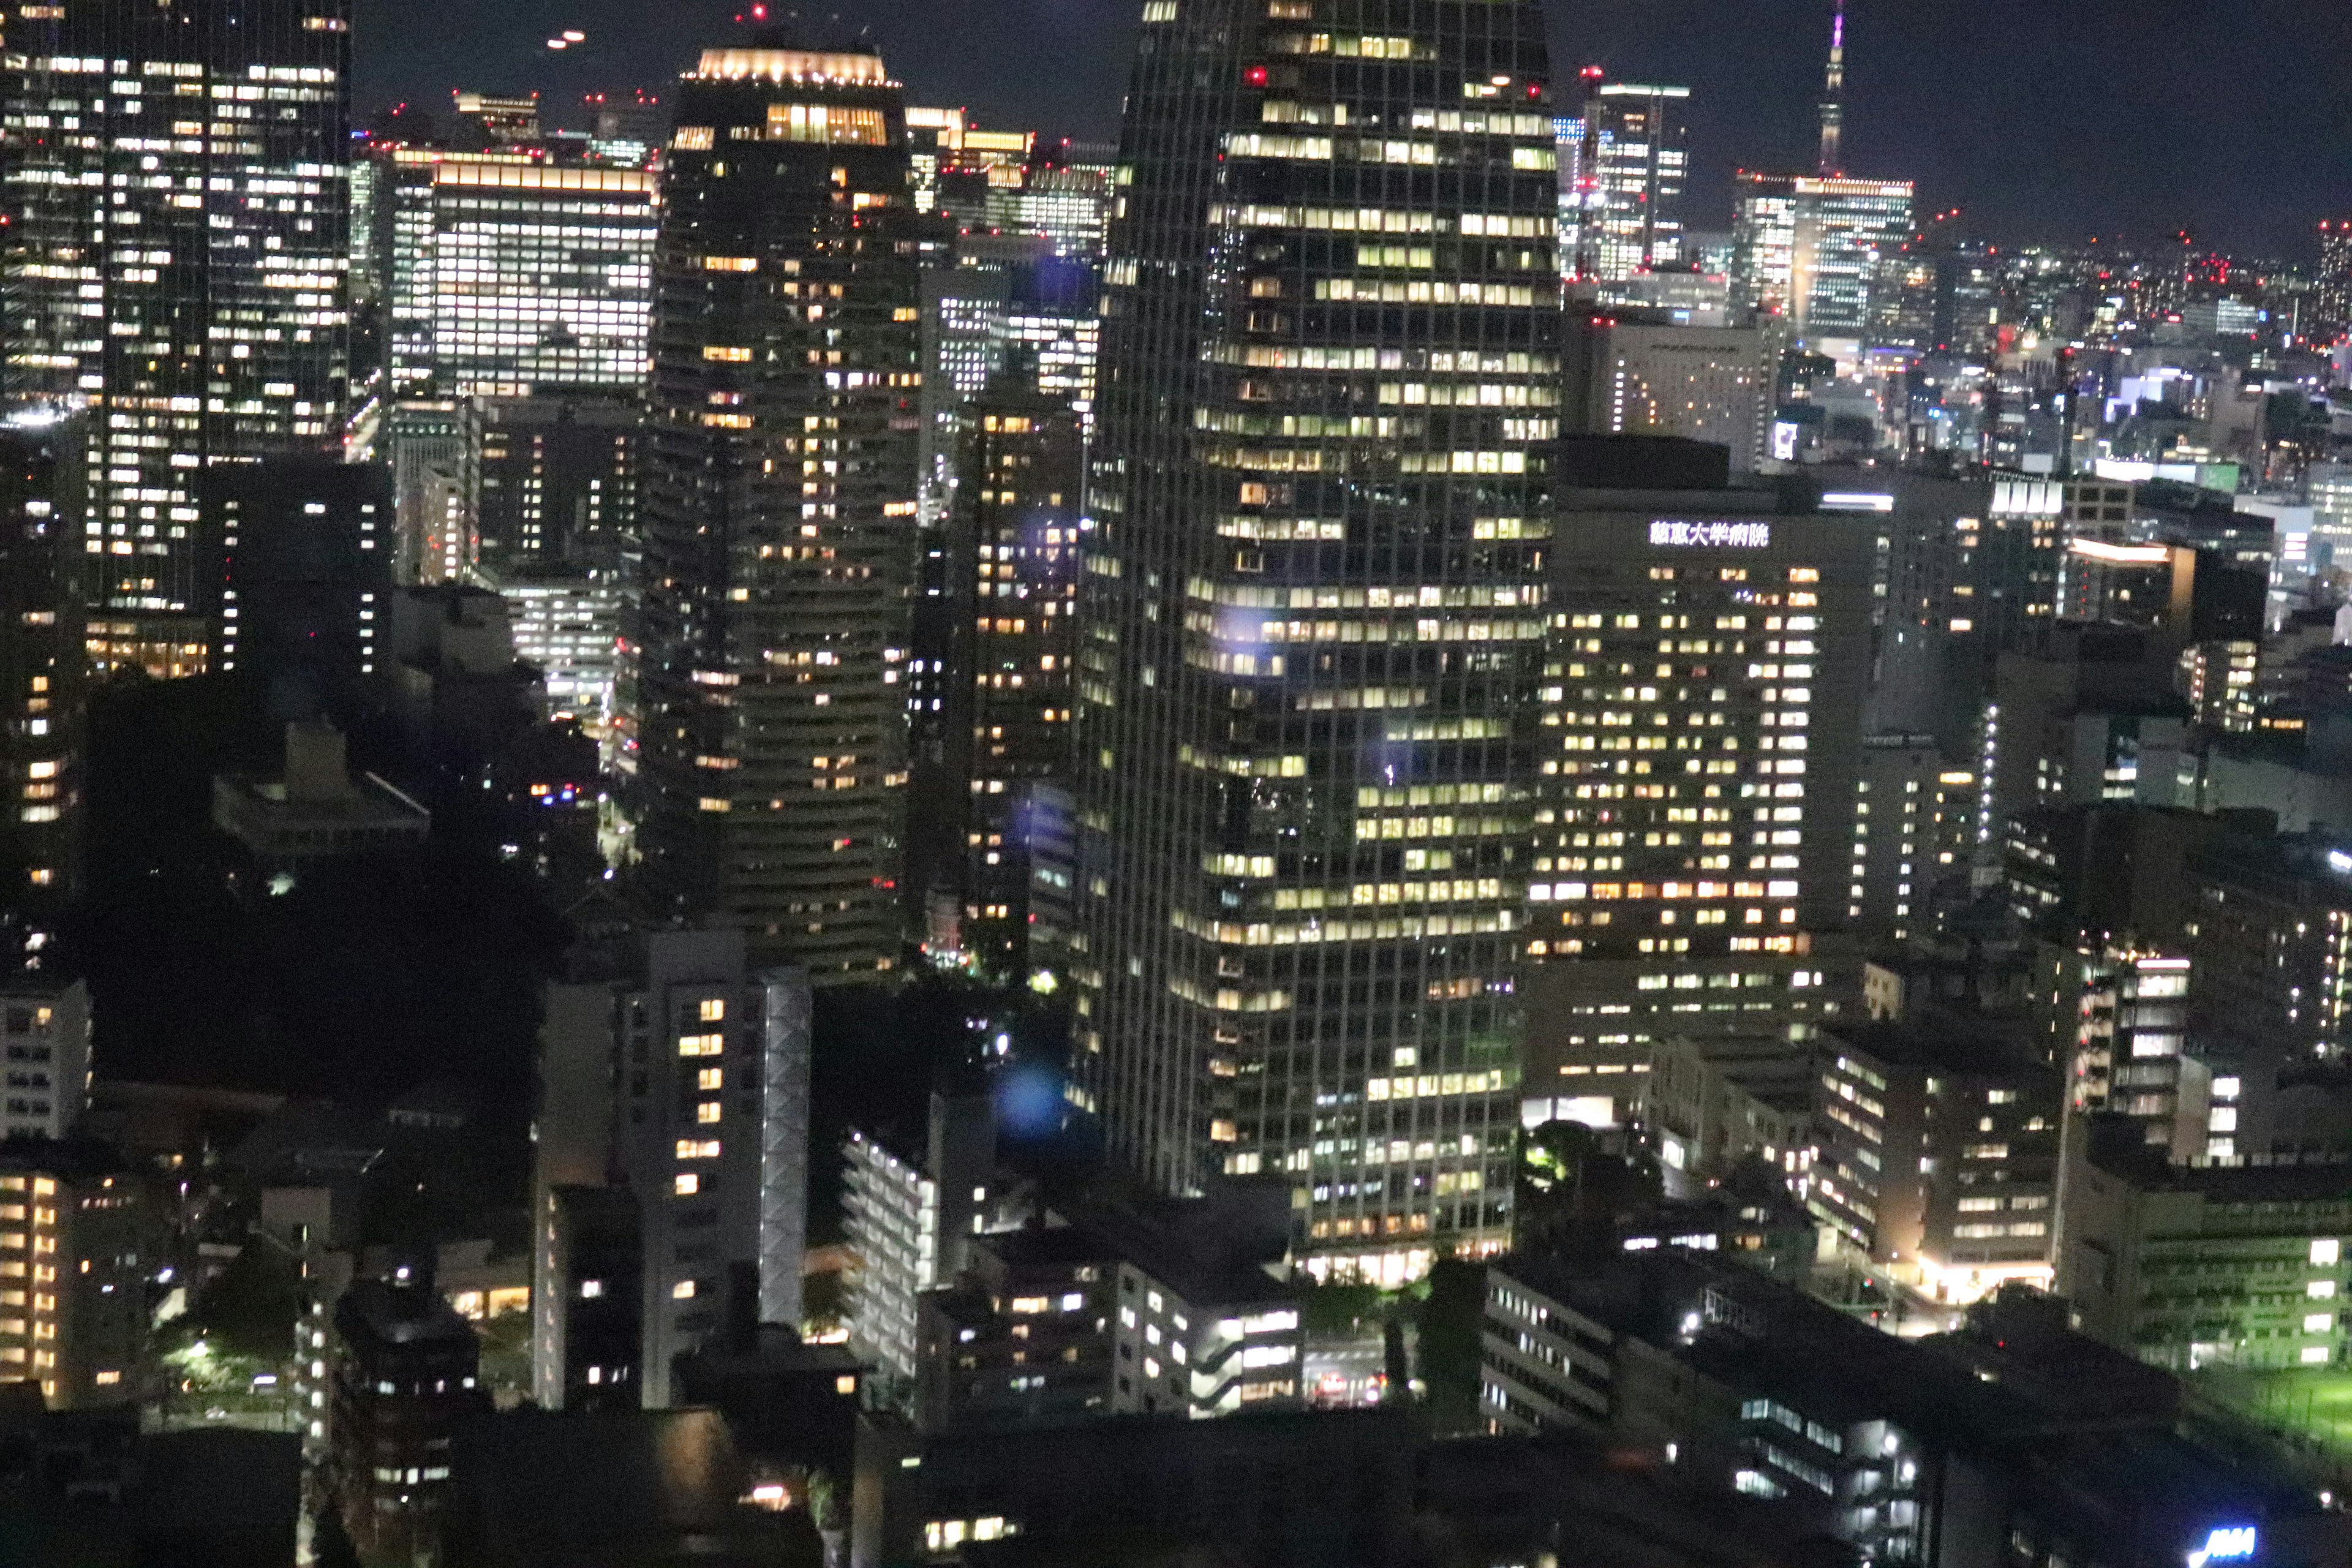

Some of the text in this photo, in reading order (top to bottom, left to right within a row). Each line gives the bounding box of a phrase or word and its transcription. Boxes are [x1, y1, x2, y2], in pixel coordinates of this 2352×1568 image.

[1649, 521, 1769, 547] 慈恵大学病院
